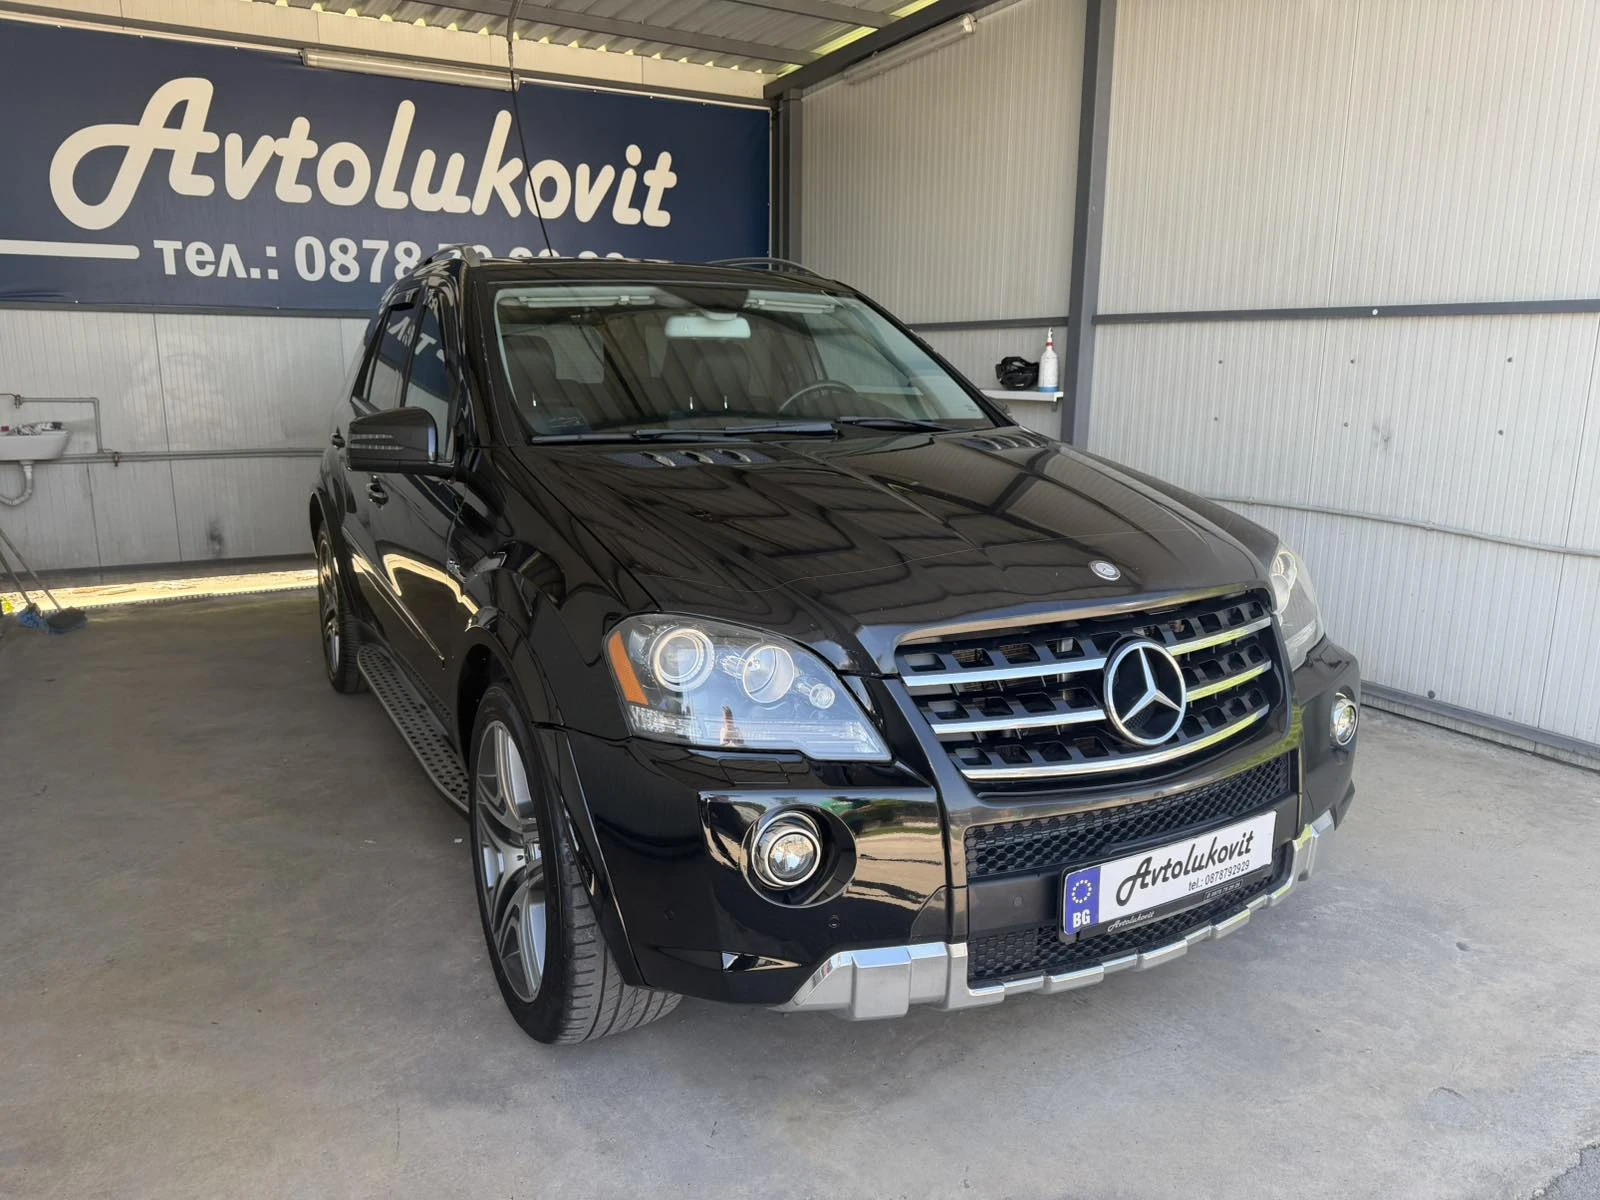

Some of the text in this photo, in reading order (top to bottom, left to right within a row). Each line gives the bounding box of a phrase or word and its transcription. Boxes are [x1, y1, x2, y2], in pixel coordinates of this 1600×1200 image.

[50, 76, 678, 231] Avtolukovit
[1116, 831, 1254, 906] Avtolukovit
[1204, 859, 1250, 885] 0878792929
[1072, 908, 1091, 928] BG
[1108, 911, 1155, 932] Avtolukovit
